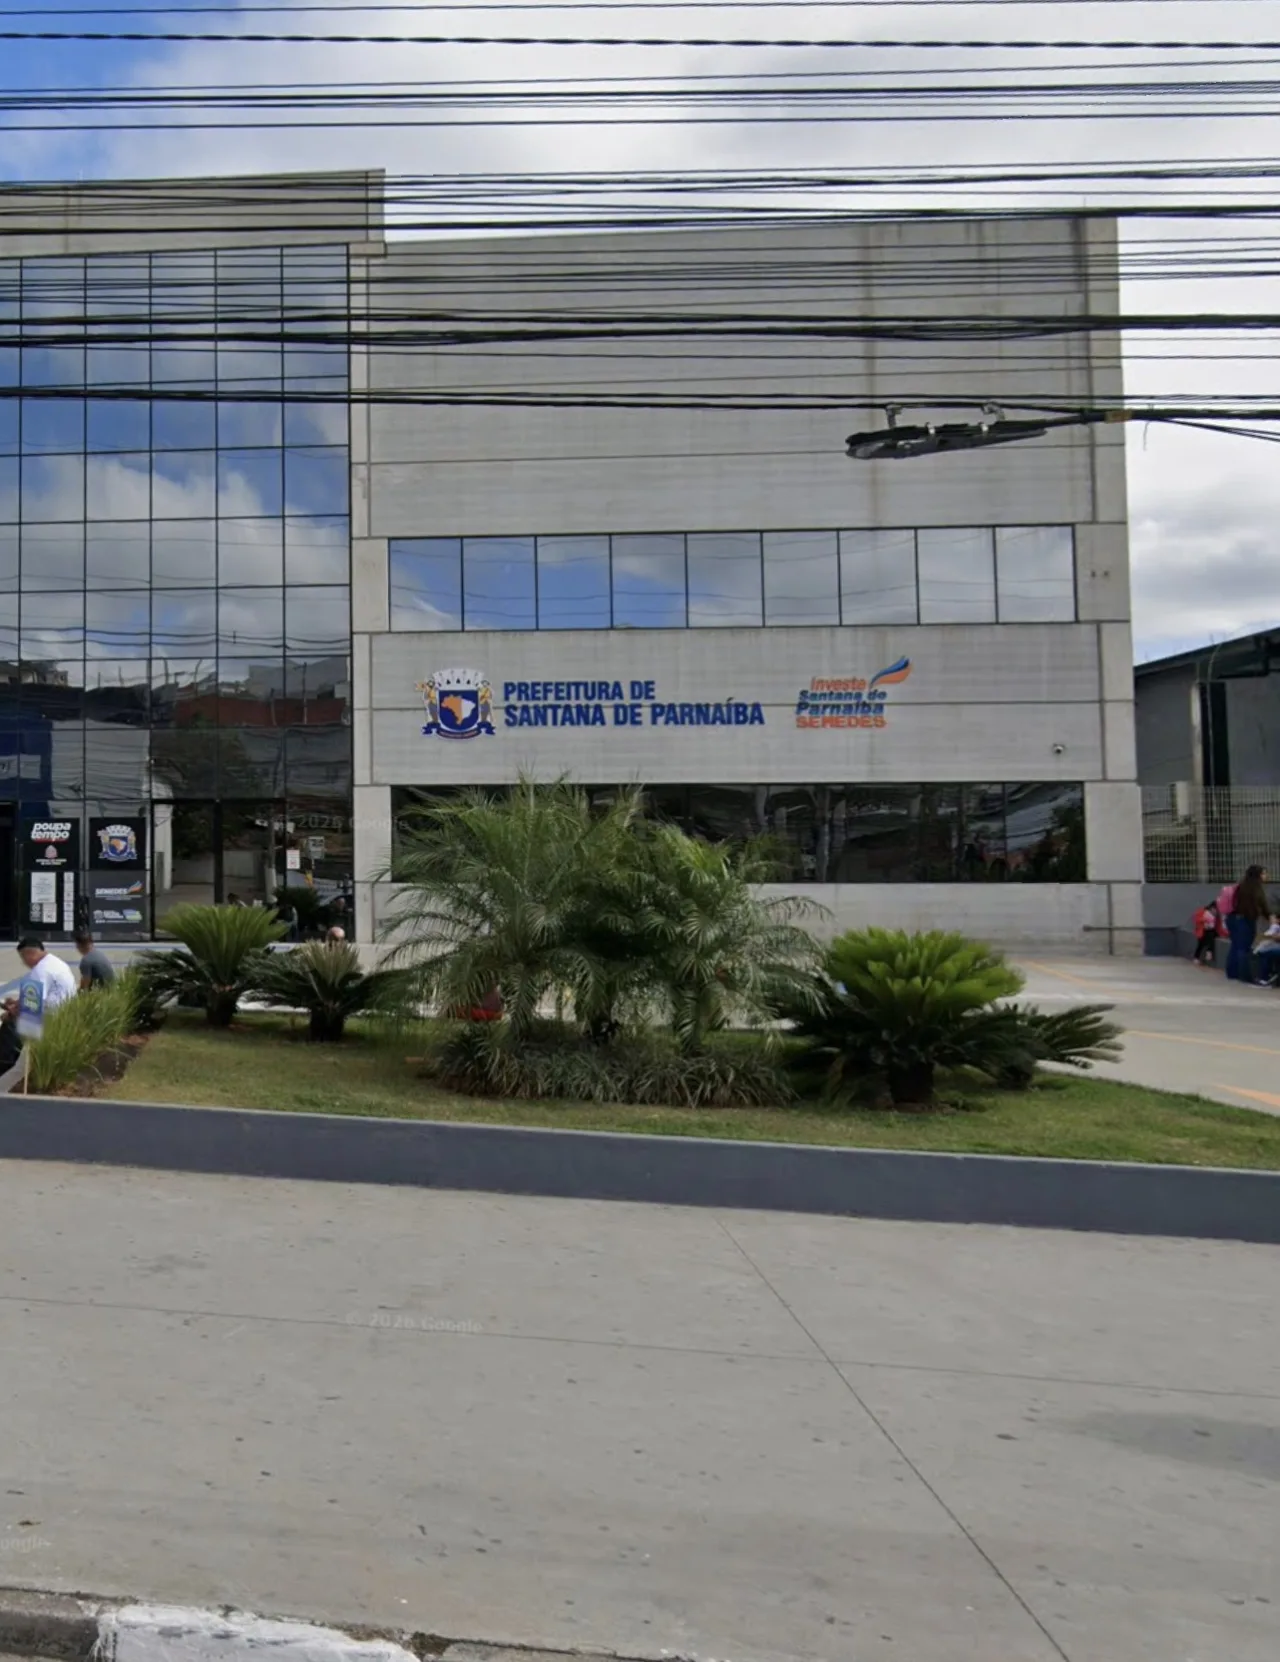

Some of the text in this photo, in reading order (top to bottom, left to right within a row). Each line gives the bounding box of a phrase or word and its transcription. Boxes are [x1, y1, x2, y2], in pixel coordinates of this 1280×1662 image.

[504, 681, 656, 702] PREFEITURA DE
[798, 689, 863, 701] Santana
[504, 697, 766, 727] SANTANA DE PARNAÍBA
[796, 715, 887, 729] SEMEDES
[33, 822, 72, 832] poupa
[30, 830, 70, 841] tempo
